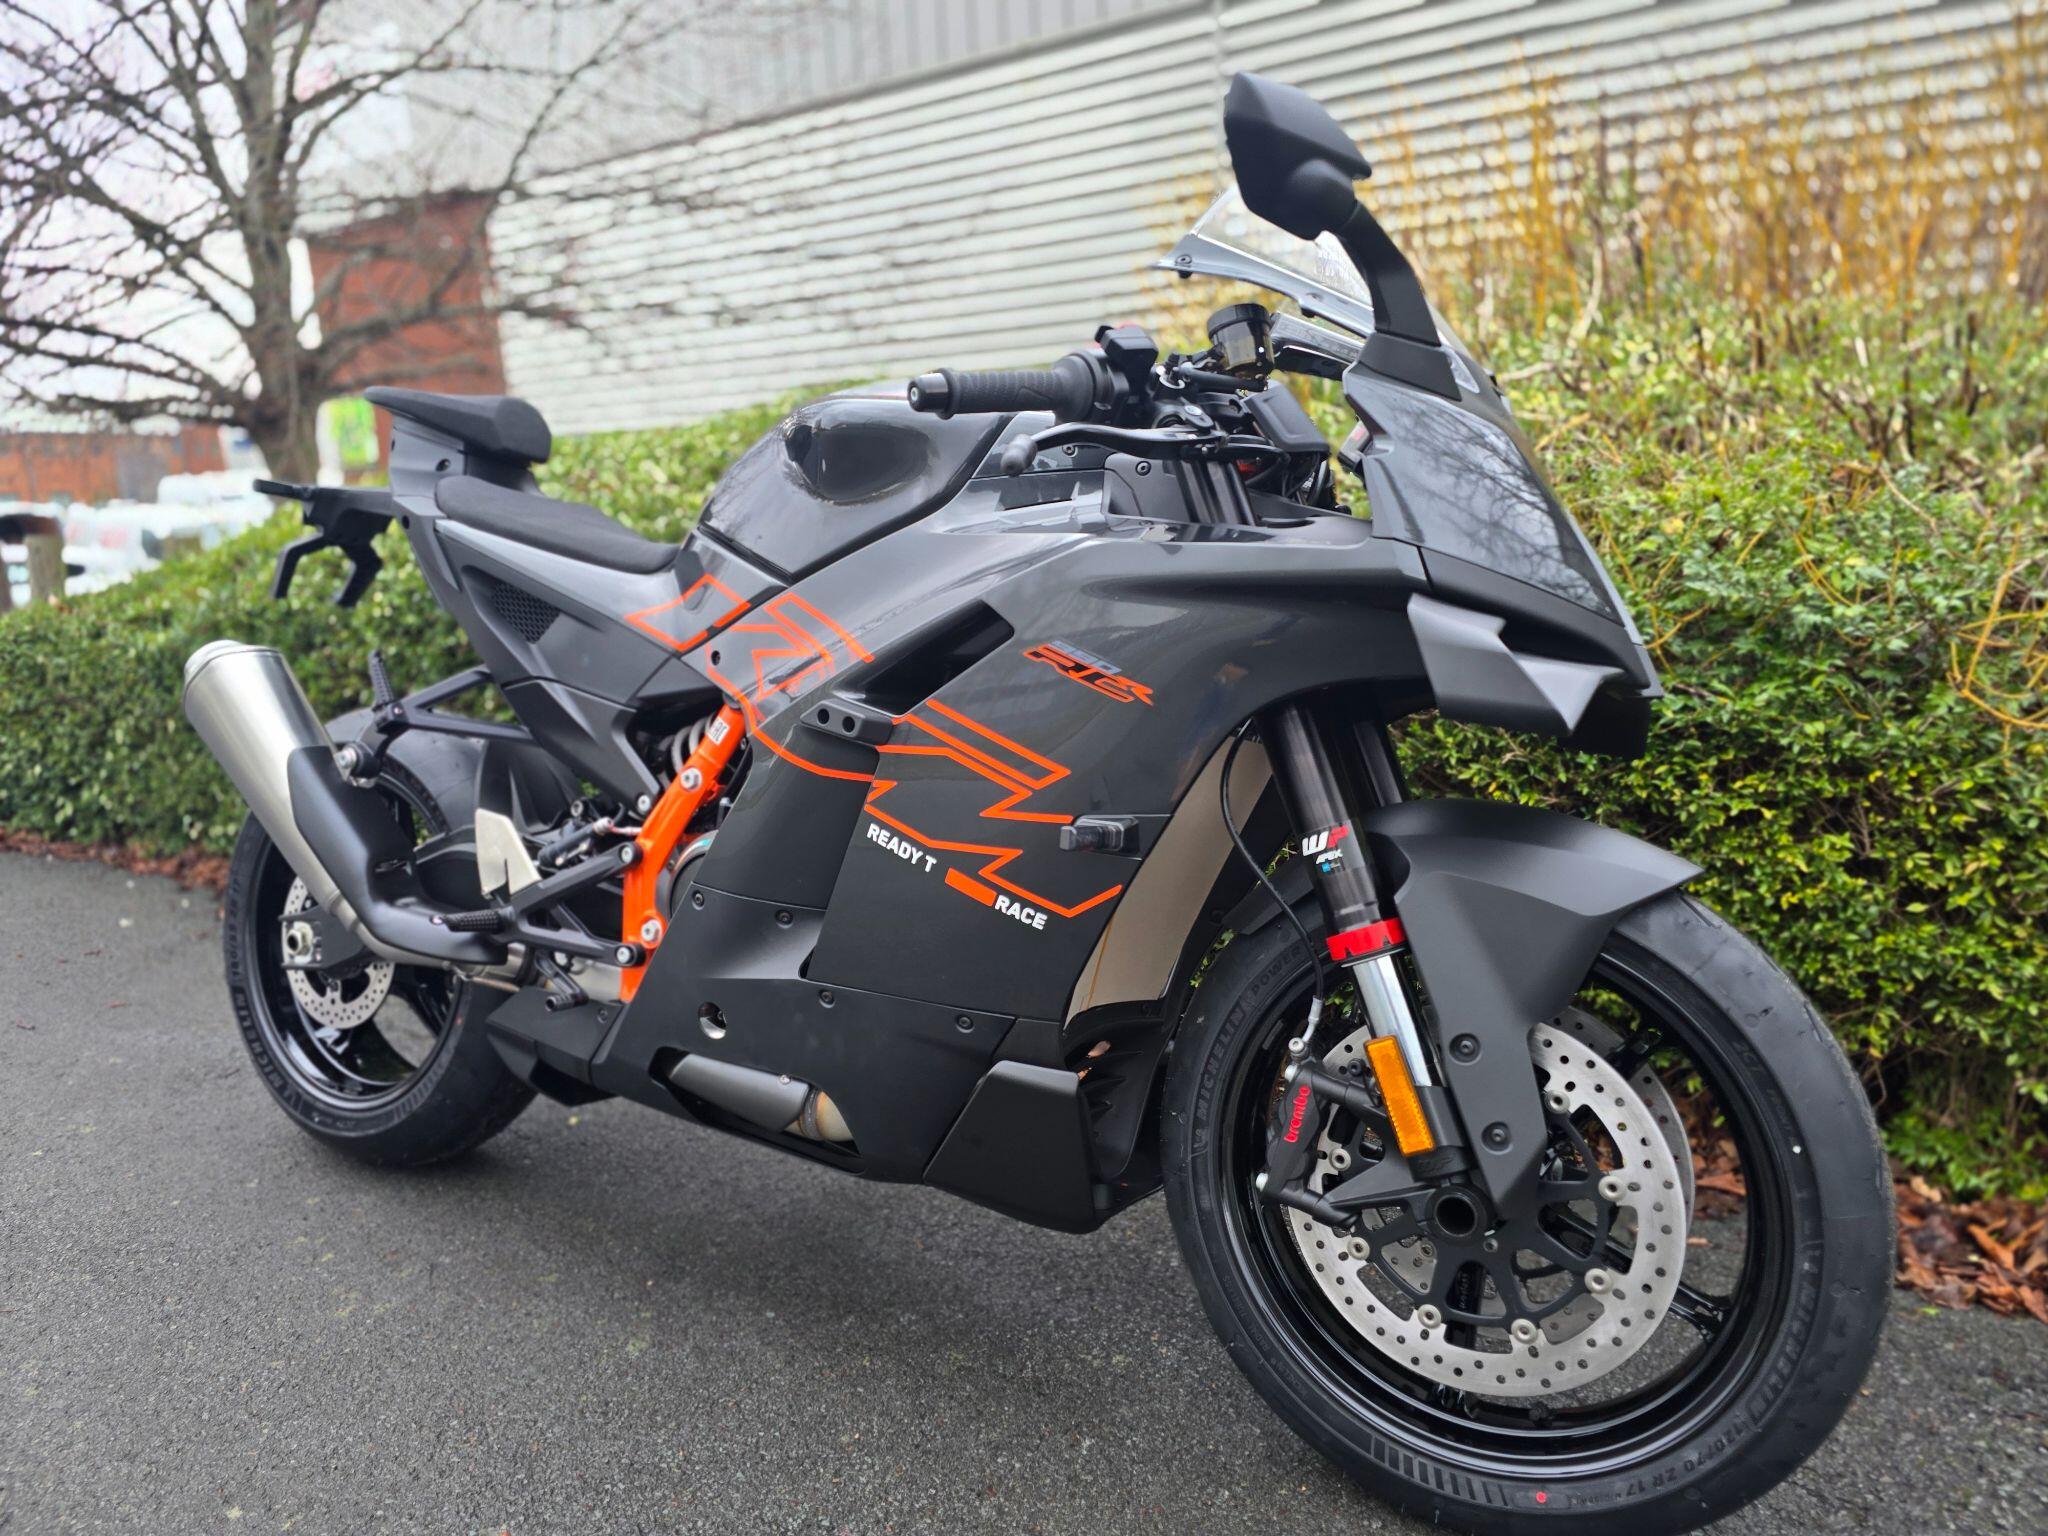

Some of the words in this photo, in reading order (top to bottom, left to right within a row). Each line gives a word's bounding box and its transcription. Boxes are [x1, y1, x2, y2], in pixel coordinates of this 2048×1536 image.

[866, 823, 924, 865] READY
[924, 854, 938, 873] T
[994, 895, 1048, 930] RACE
[1302, 825, 1349, 857] WP
[1195, 1005, 1246, 1122] MICHELIN
[1284, 1085, 1311, 1142] brembo
